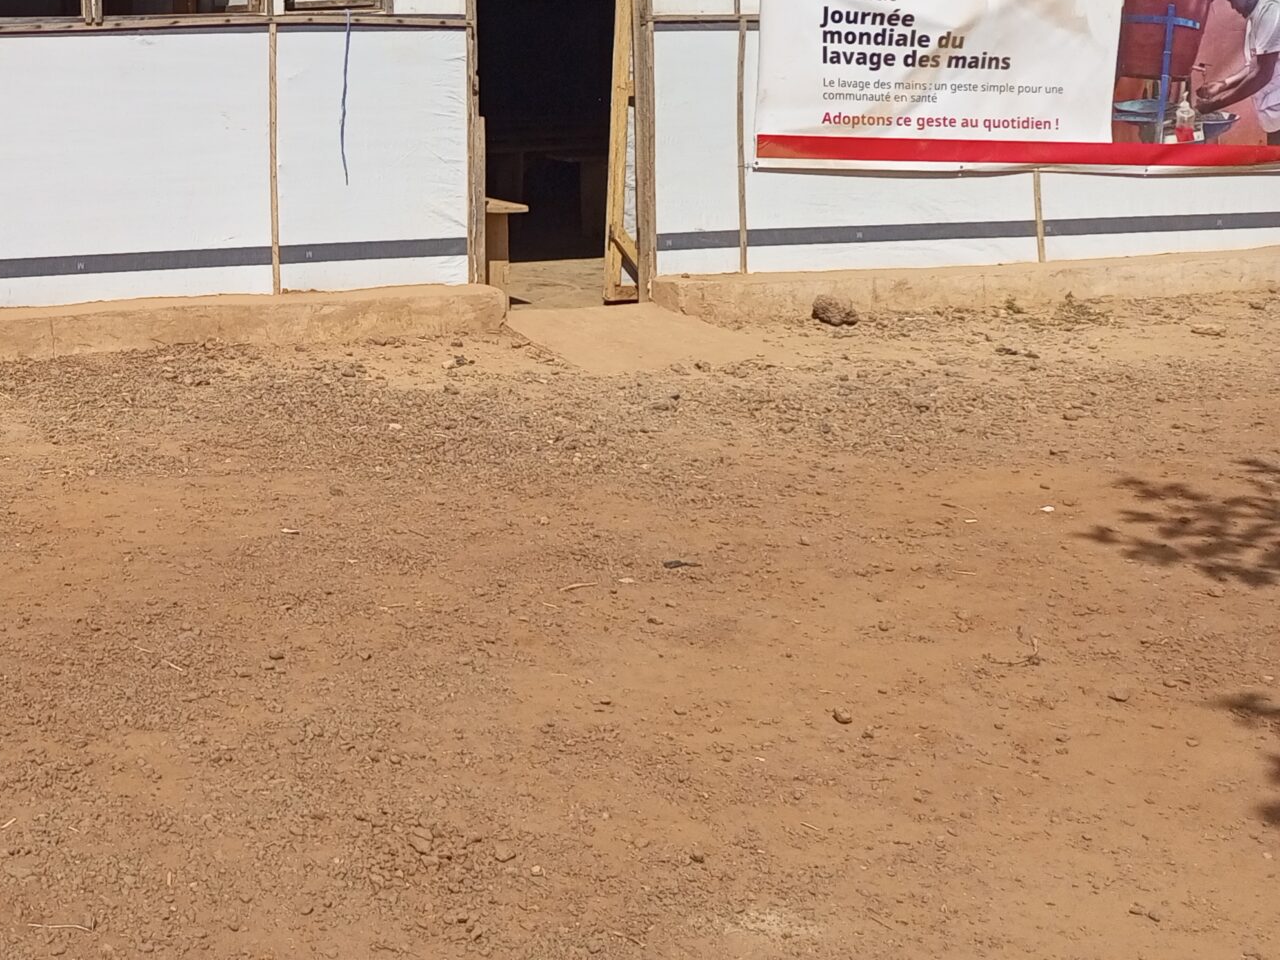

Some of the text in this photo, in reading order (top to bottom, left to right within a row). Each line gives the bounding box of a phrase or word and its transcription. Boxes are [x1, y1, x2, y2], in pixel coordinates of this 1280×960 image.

[819, 6, 915, 28] Journée
[822, 28, 965, 49] mondiale du
[822, 46, 1011, 71] lavage des mains
[822, 91, 938, 103] communauté en santé
[823, 78, 835, 88] Le
[838, 78, 871, 91] lavage
[873, 79, 892, 90] des
[934, 82, 947, 91] un
[950, 82, 978, 94] geste
[981, 82, 1015, 95] simple
[1018, 85, 1043, 96] pour
[1045, 86, 1064, 94] une
[821, 112, 893, 129] Adoptons
[896, 116, 912, 127] ce
[916, 116, 957, 131] geste
[961, 118, 978, 128] au
[983, 116, 1051, 132] quotidien
